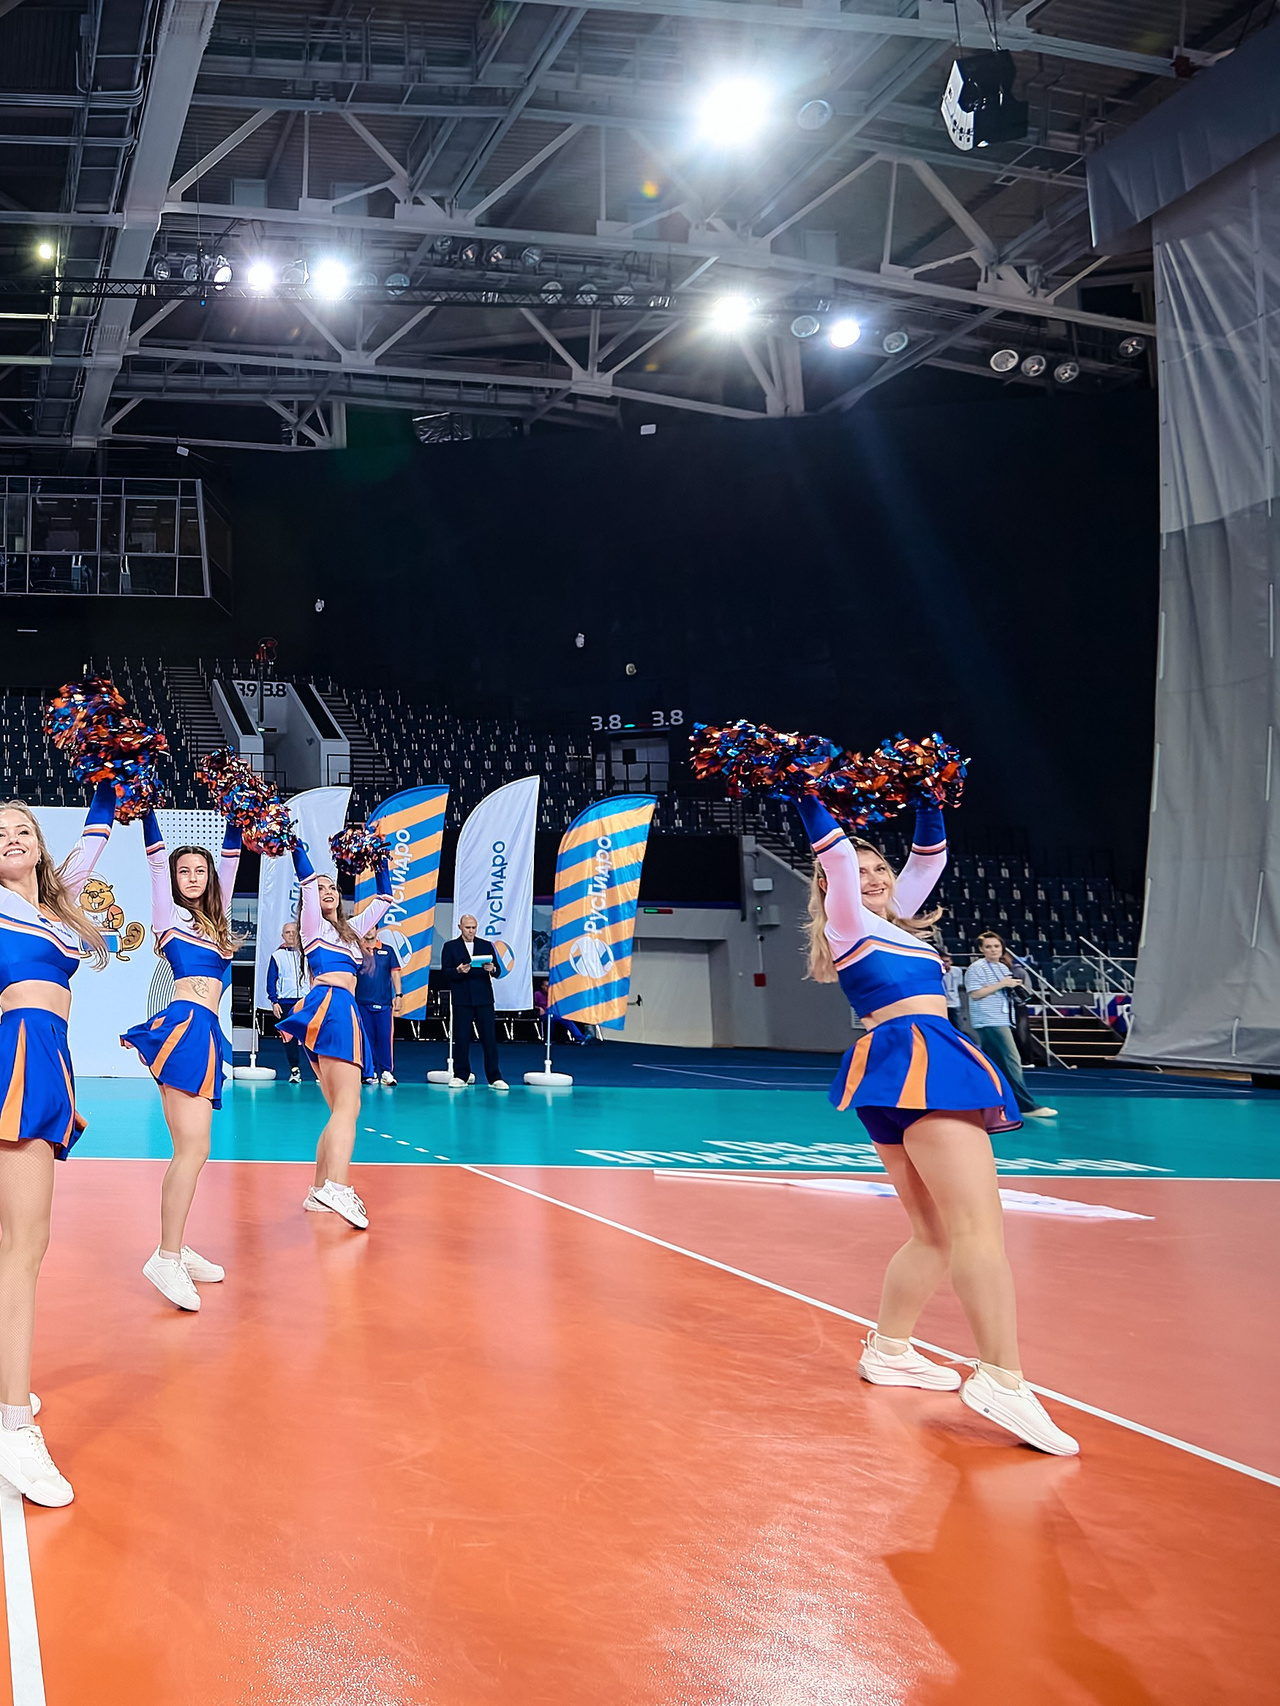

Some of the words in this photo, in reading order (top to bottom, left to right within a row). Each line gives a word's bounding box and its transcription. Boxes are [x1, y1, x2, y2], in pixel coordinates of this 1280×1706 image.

[263, 683, 287, 698] 3.8
[590, 714, 622, 731] 3.8
[651, 709, 684, 726] 3.8
[483, 840, 507, 937] РусГидро
[584, 835, 612, 935] РусГидро
